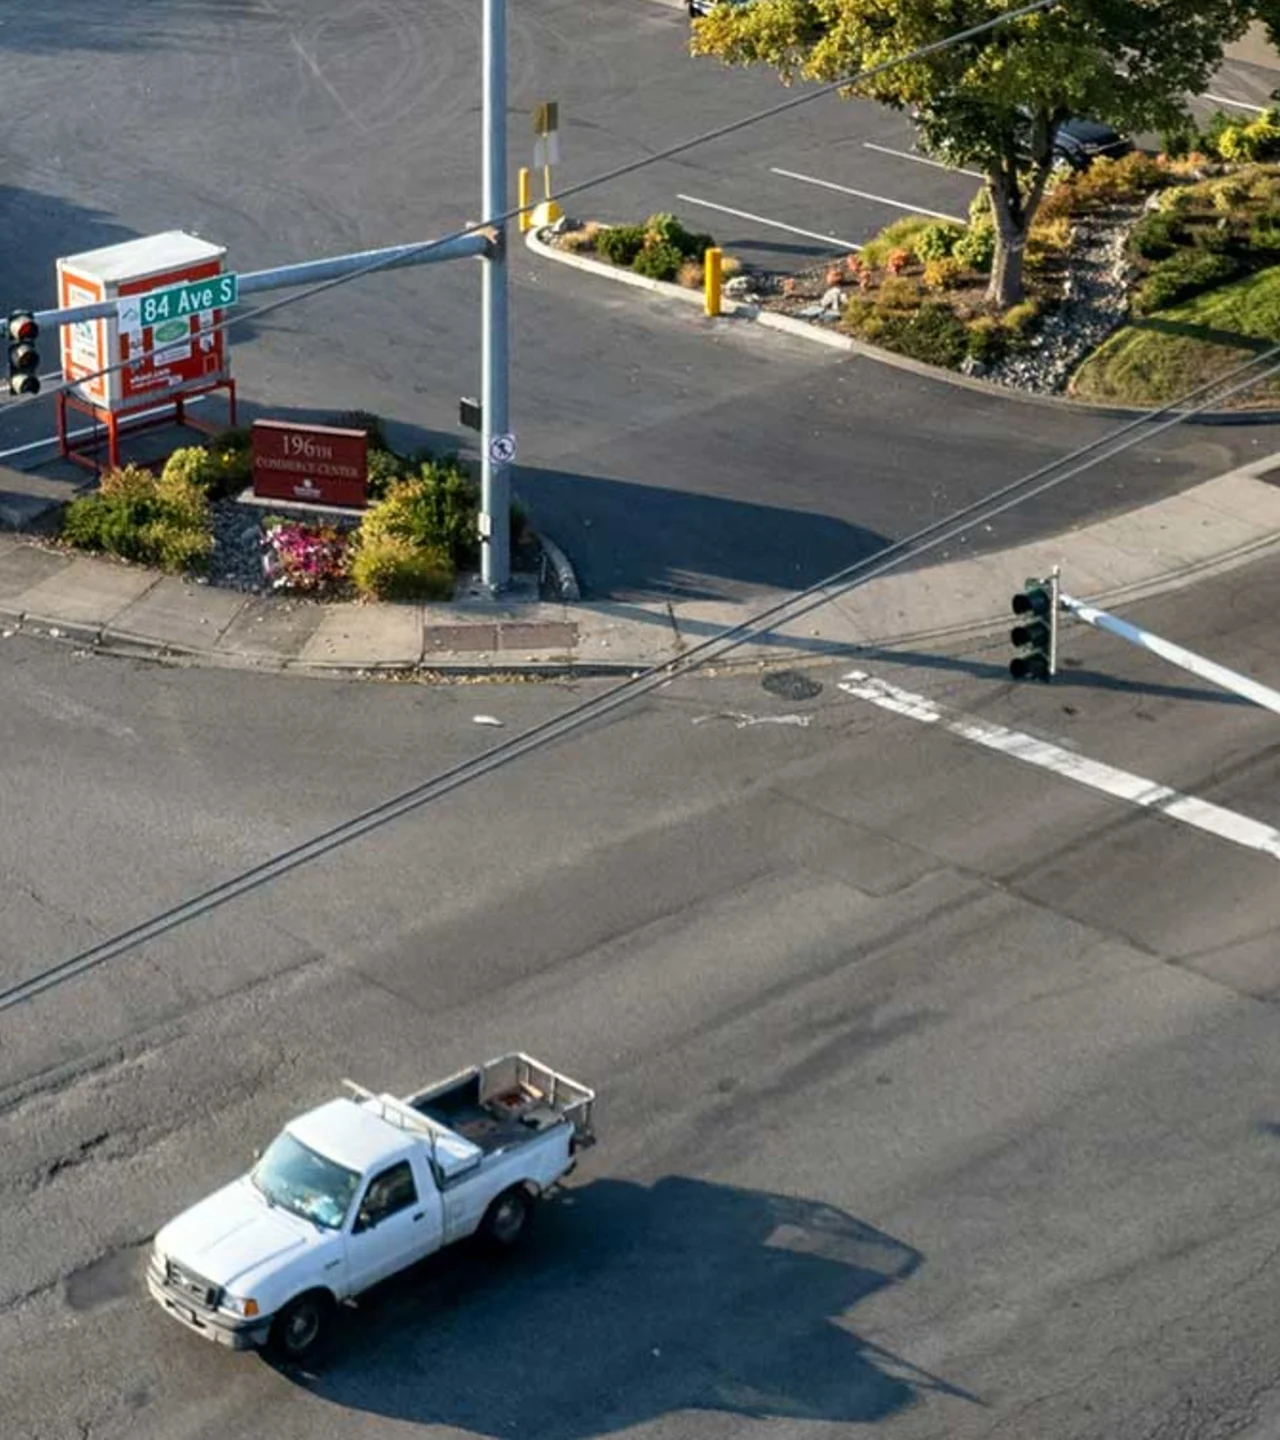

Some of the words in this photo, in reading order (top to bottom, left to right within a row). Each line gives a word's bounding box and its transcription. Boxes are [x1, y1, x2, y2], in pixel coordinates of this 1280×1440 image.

[144, 298, 169, 322] 84
[178, 289, 213, 314] Ave
[220, 278, 232, 302] S
